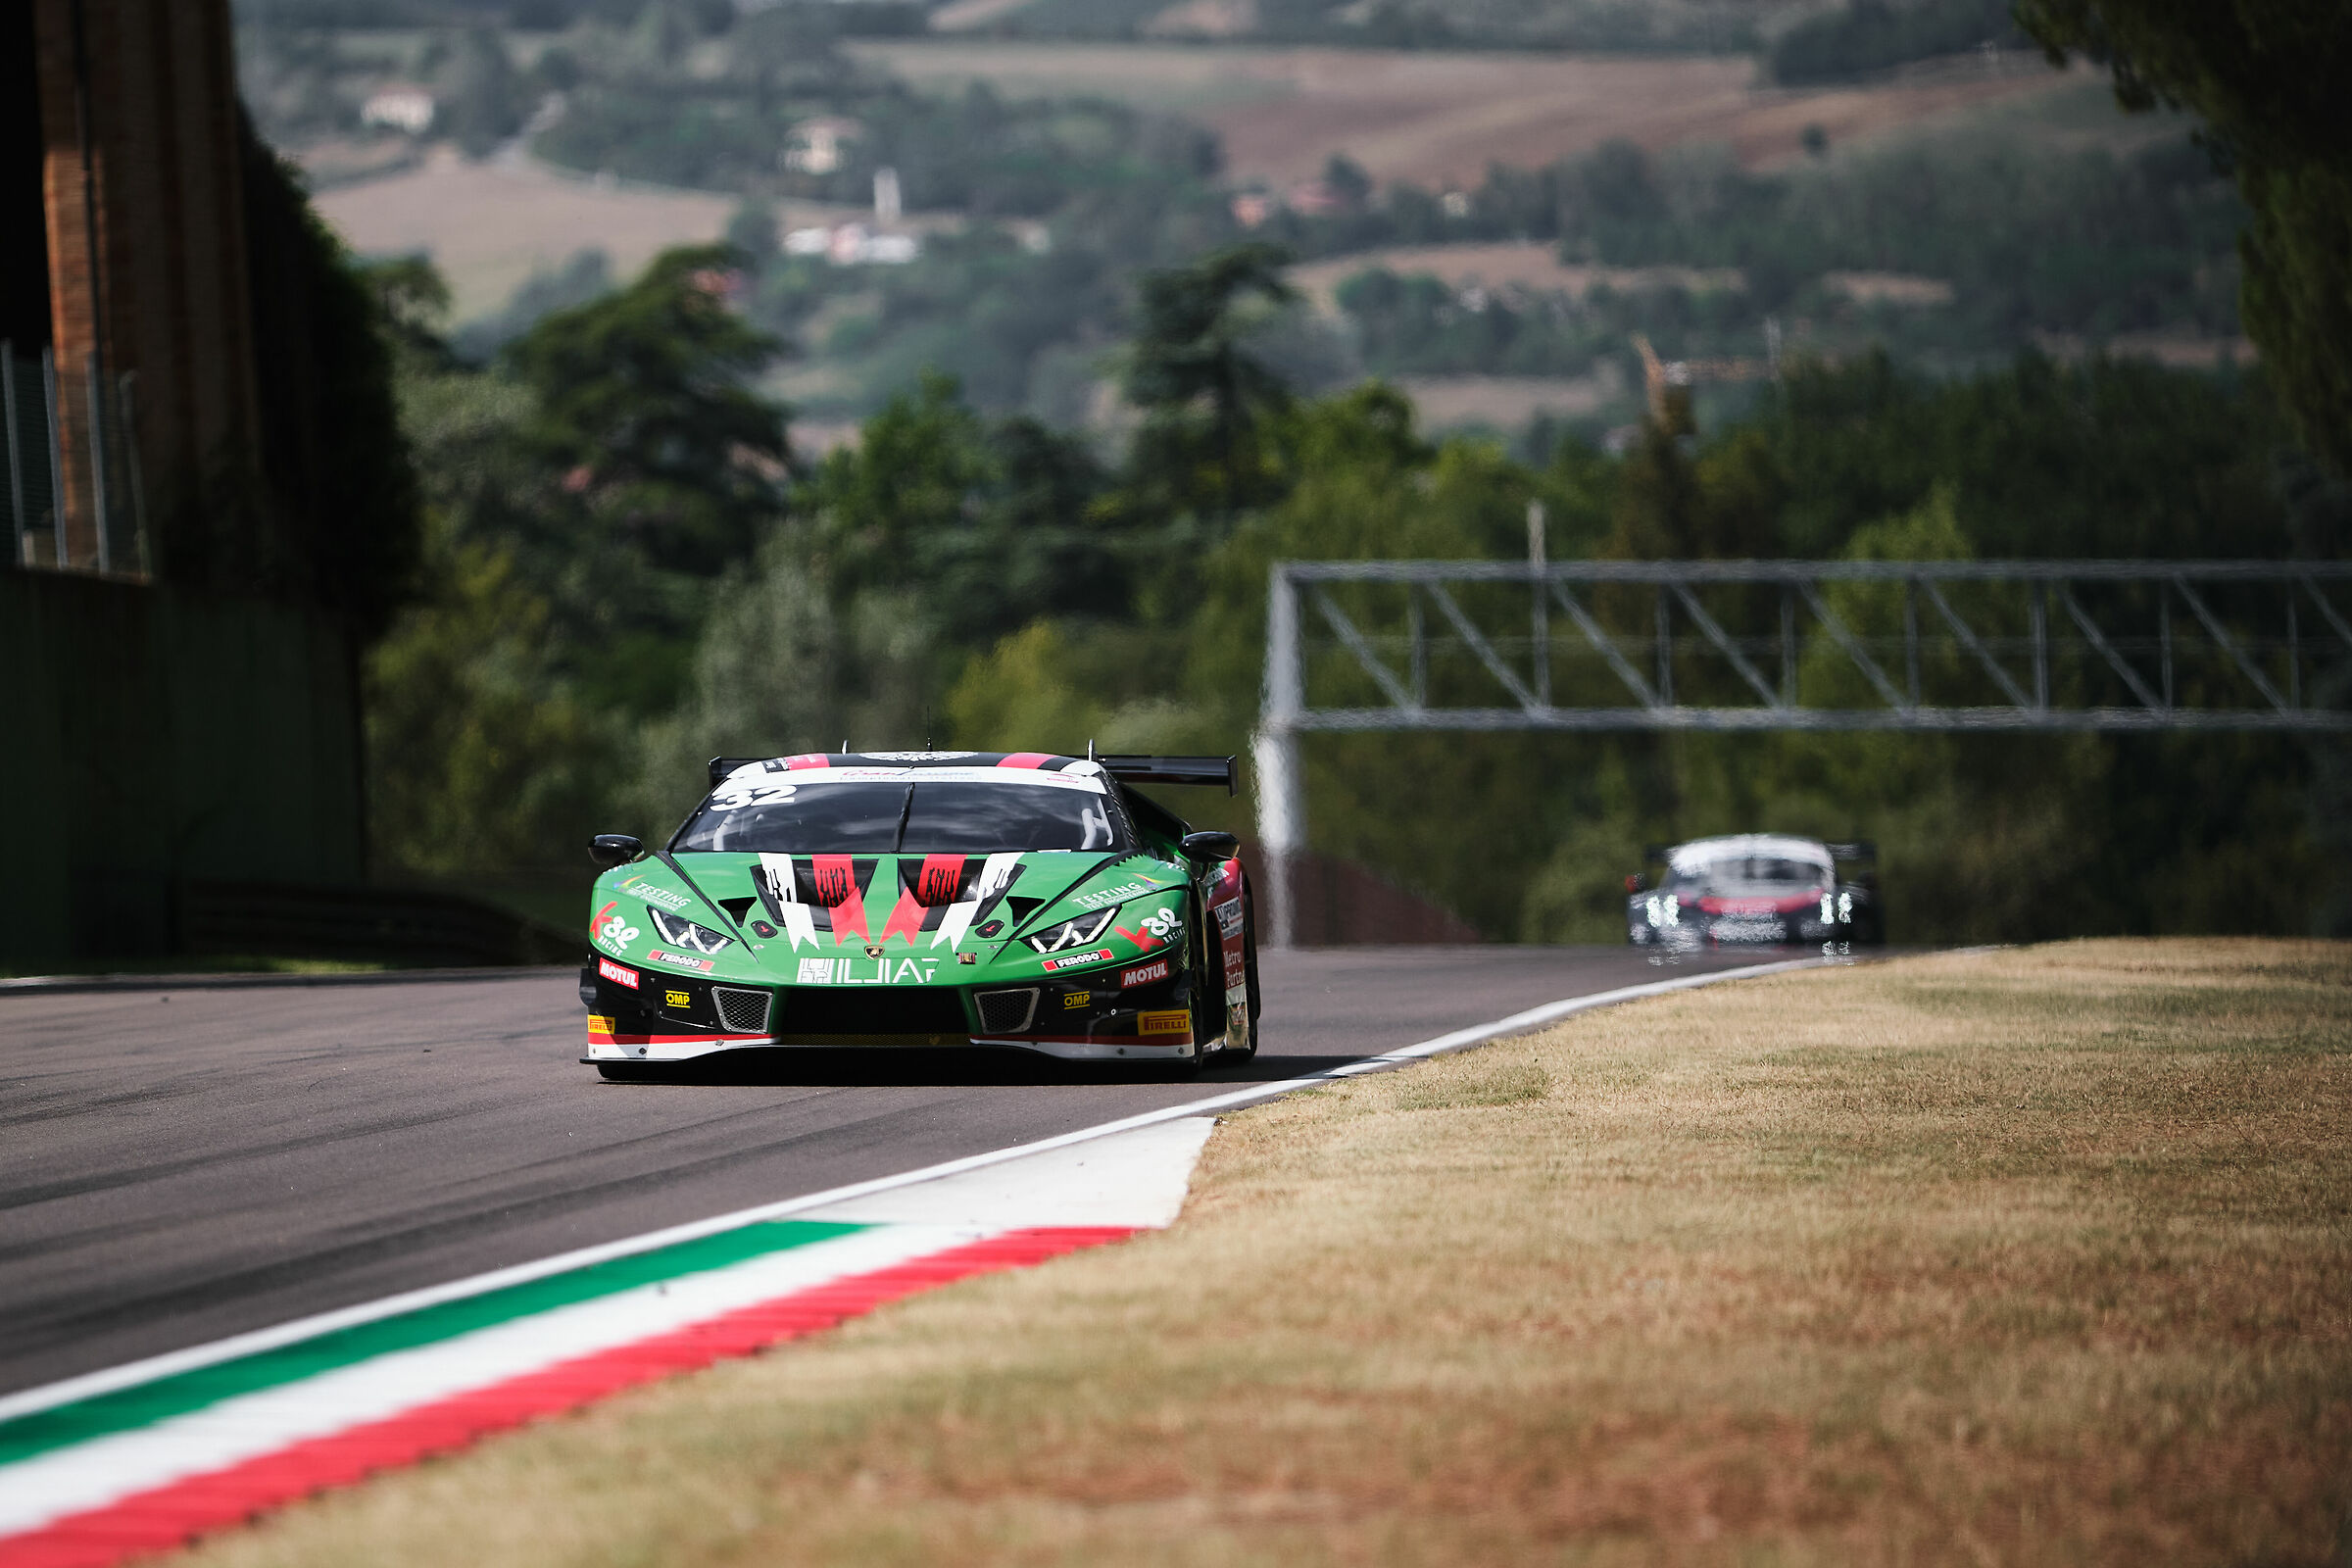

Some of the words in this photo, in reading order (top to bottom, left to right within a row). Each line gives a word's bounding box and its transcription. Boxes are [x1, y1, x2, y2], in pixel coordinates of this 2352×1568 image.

[710, 785, 797, 811] 32
[635, 882, 691, 907] TESTING
[1072, 882, 1142, 906] TESTING
[660, 953, 701, 967] FERODO
[1056, 953, 1100, 968] FERODO
[1223, 950, 1242, 967] Metro
[601, 962, 637, 987] MOTUL
[1124, 962, 1166, 986] MOTUL
[665, 993, 690, 1005] OMP
[1064, 994, 1090, 1006] OMP
[589, 1018, 612, 1031] PIRELLI
[1144, 1013, 1187, 1031] PIRELLI
